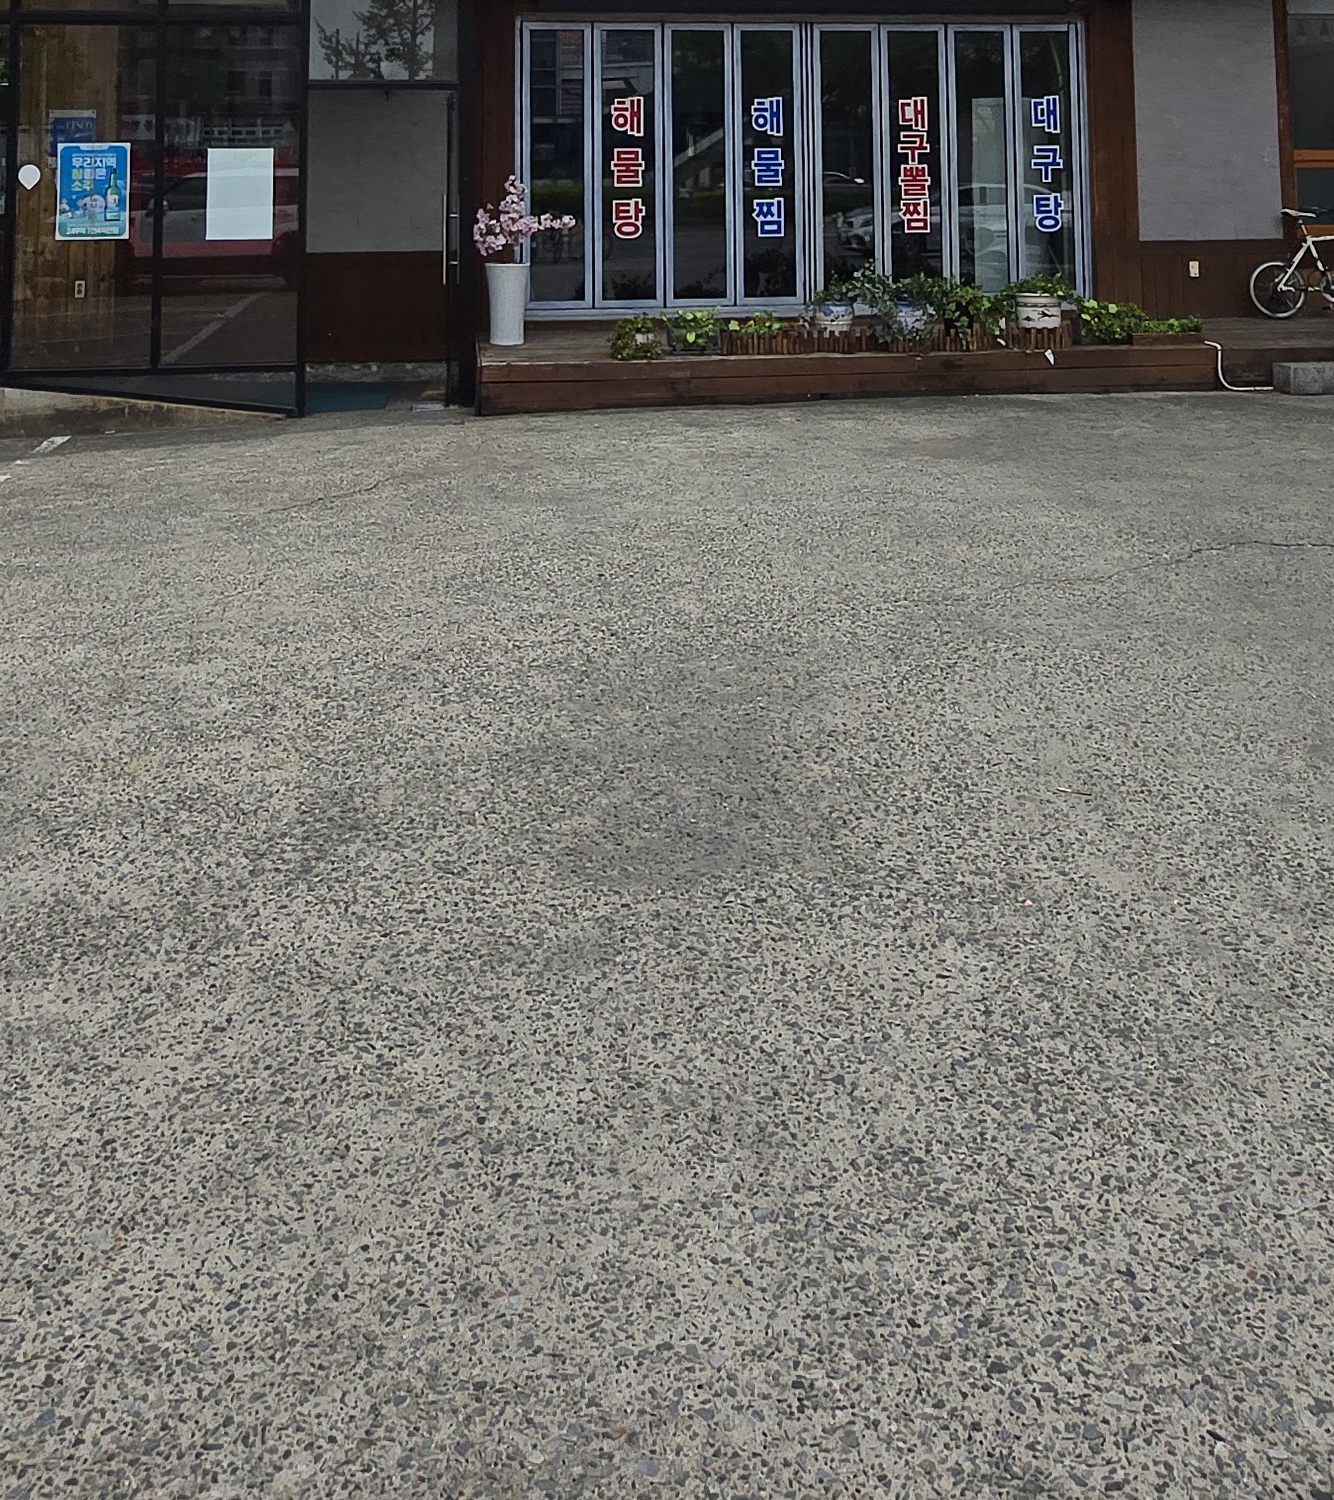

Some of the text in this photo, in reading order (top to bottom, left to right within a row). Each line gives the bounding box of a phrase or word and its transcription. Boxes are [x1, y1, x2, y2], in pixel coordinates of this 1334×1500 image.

[611, 97, 646, 239] 해물탕
[751, 97, 785, 238] 해물찜
[898, 97, 931, 234] 대구뽈찜
[1031, 95, 1064, 233] 대구탕
